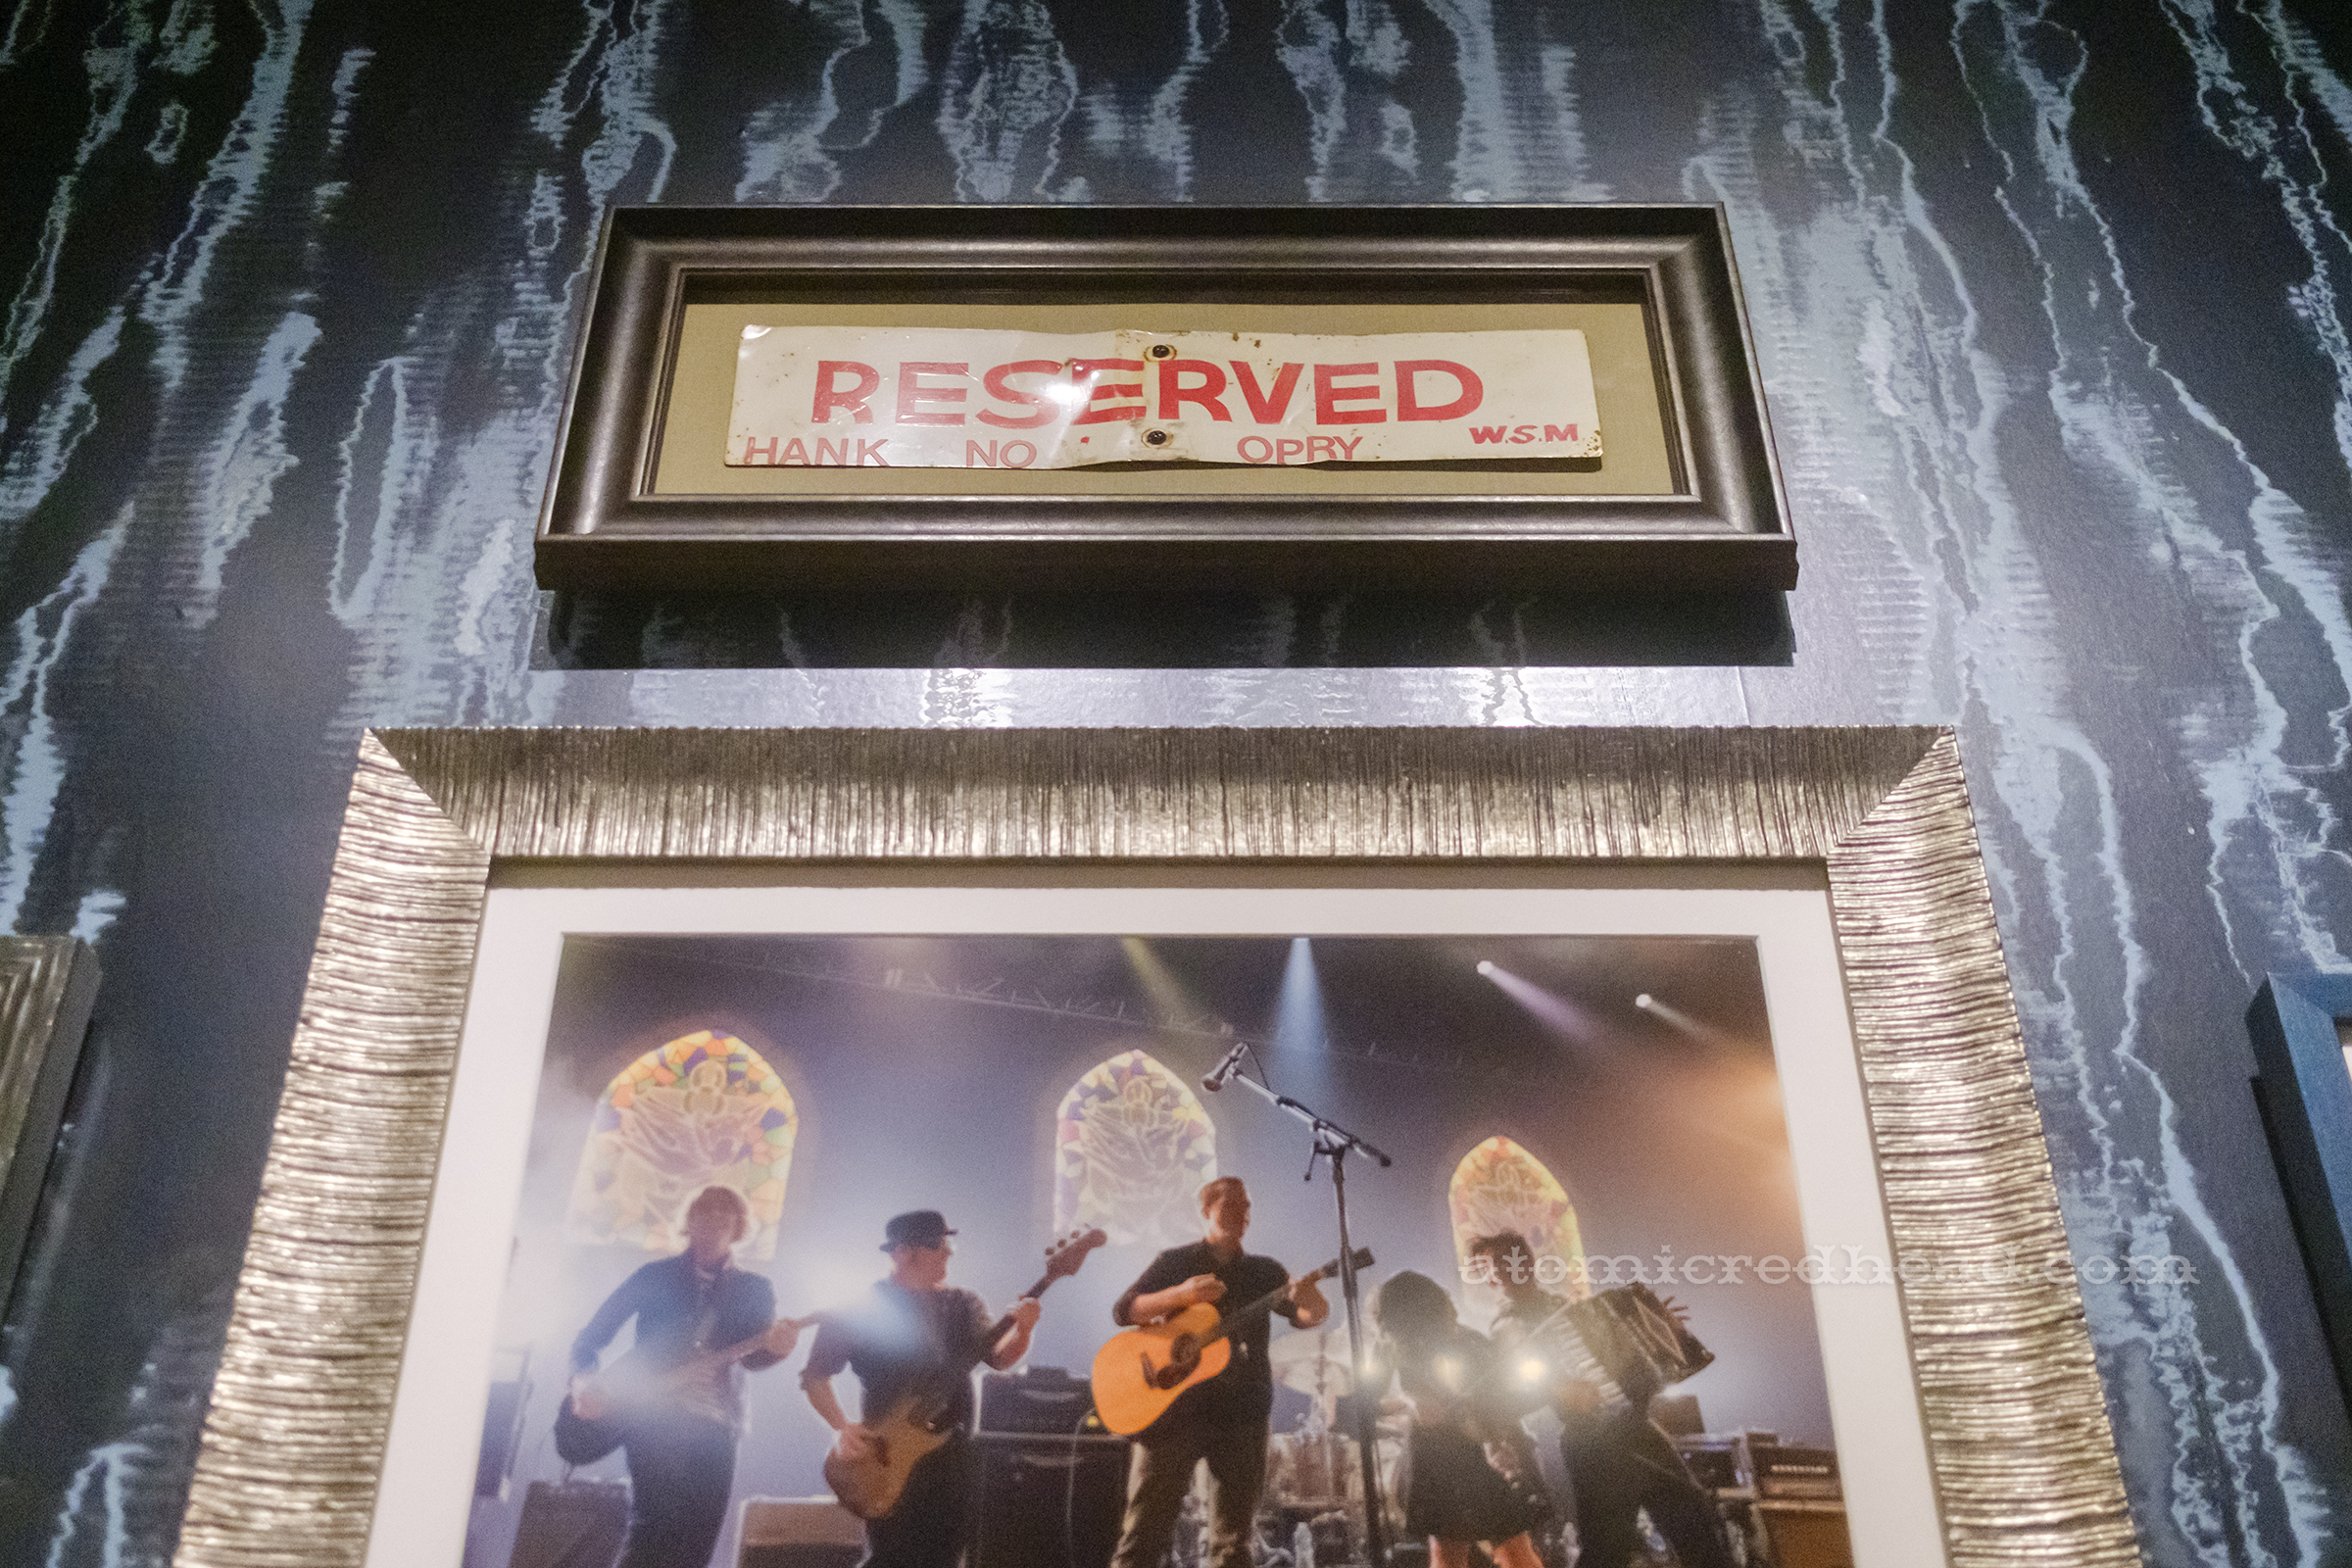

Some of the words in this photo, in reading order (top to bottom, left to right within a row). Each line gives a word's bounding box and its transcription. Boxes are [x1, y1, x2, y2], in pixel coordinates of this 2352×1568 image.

[811, 359, 1484, 428] RESERVED
[744, 437, 889, 466] HANK
[965, 439, 1038, 467] NO
[1237, 435, 1363, 465] OPRY
